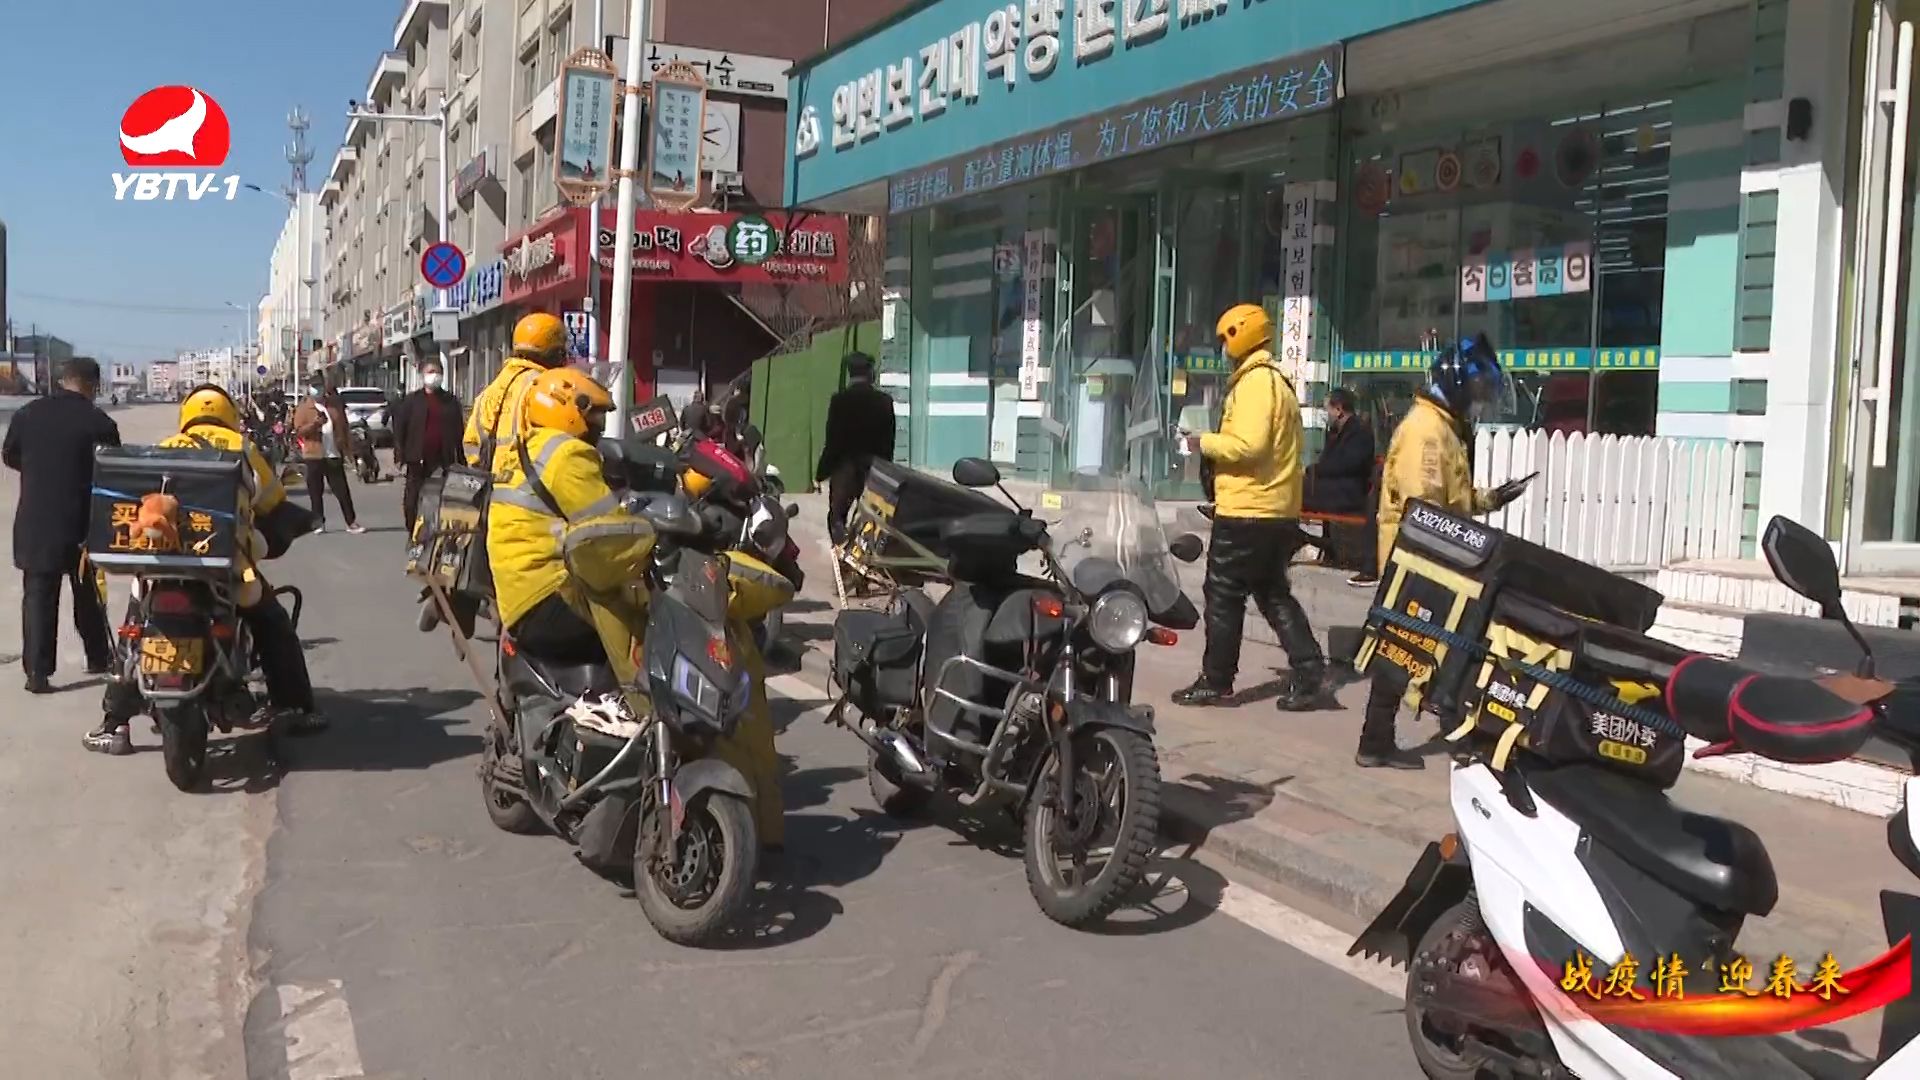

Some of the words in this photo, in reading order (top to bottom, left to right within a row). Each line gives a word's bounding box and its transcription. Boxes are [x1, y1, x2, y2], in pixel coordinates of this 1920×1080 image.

[735, 221, 769, 256] 药
[634, 408, 665, 430] 1438
[1410, 506, 1487, 549] A2021045-068
[1590, 710, 1657, 749] 美团外卖
